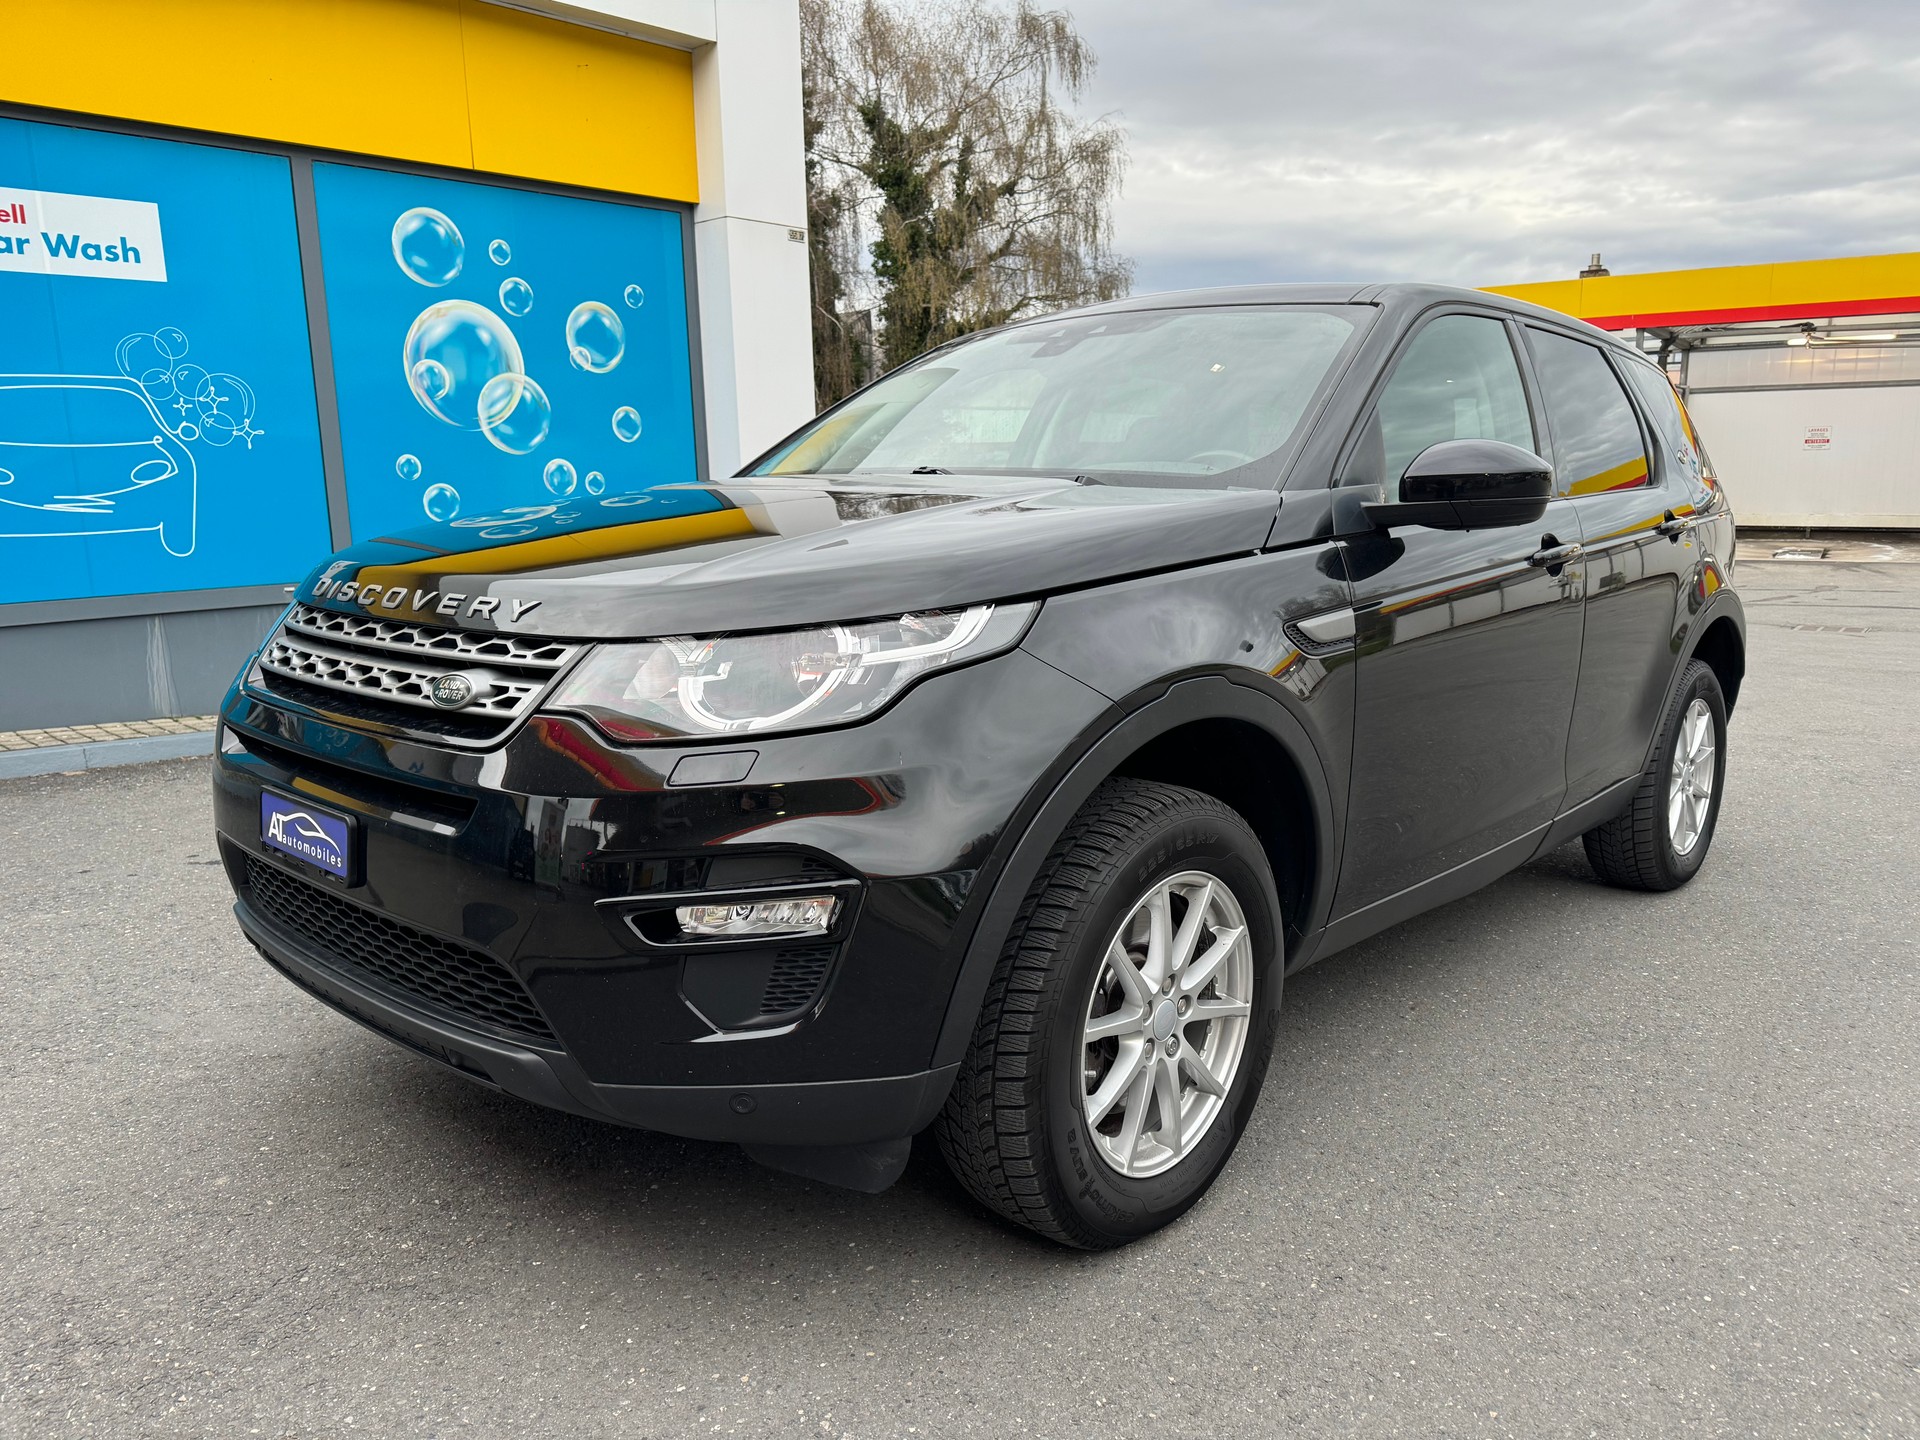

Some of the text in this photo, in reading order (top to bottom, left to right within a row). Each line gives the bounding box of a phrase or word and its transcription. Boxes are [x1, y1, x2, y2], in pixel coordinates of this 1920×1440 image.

[40, 231, 141, 264] Wash
[311, 577, 543, 622] DISCOVERY
[437, 689, 463, 700] ROVER
[439, 679, 461, 690] LAND
[282, 834, 342, 868] automobiles
